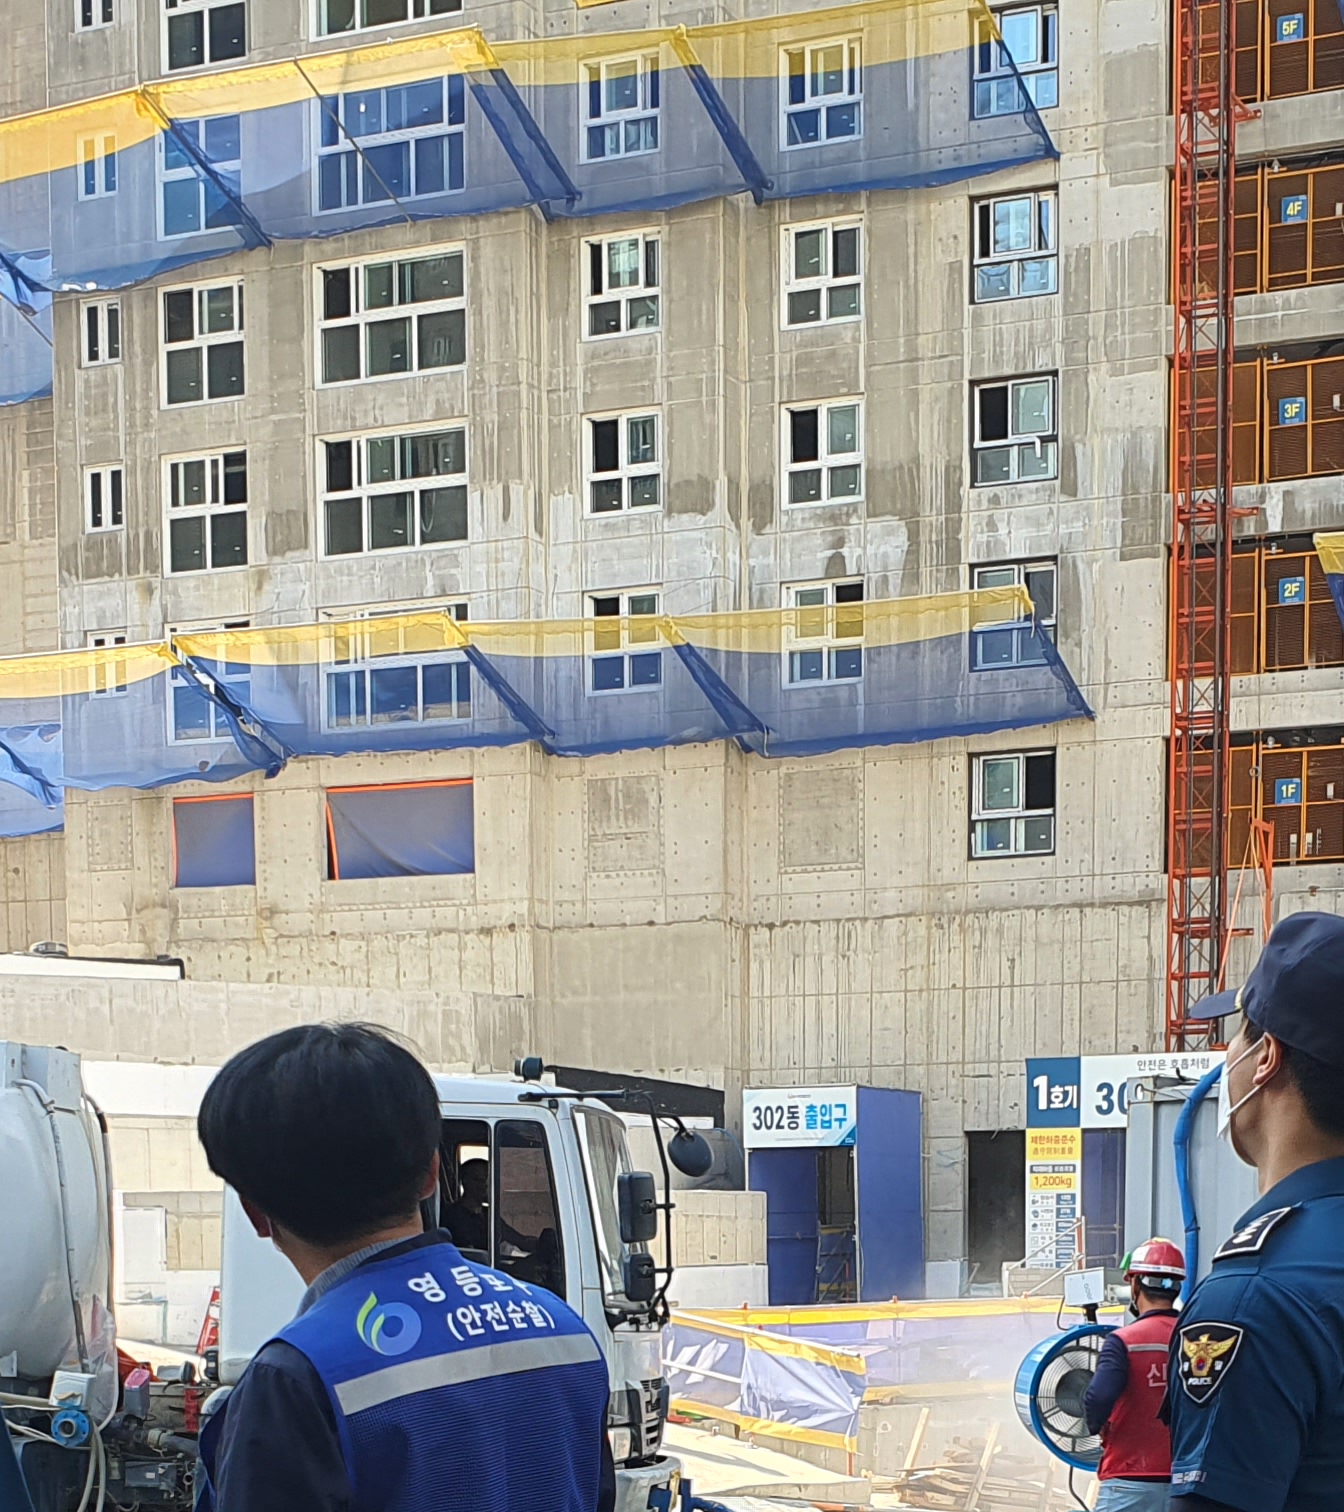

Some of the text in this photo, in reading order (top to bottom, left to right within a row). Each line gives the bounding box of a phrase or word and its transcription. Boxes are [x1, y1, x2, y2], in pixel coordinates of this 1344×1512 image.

[1282, 19, 1299, 36] 5F
[1286, 200, 1303, 216] 4F
[1284, 402, 1301, 418] 3F
[1283, 582, 1301, 598] 2F
[1281, 783, 1297, 798] 1F
[1136, 1057, 1168, 1072] 안전은
[1032, 1074, 1078, 1111] 1호기
[751, 1103, 848, 1131] 302동 출입구
[1033, 1175, 1073, 1189] 1,200kg
[446, 1299, 556, 1342] (안전순찰)
